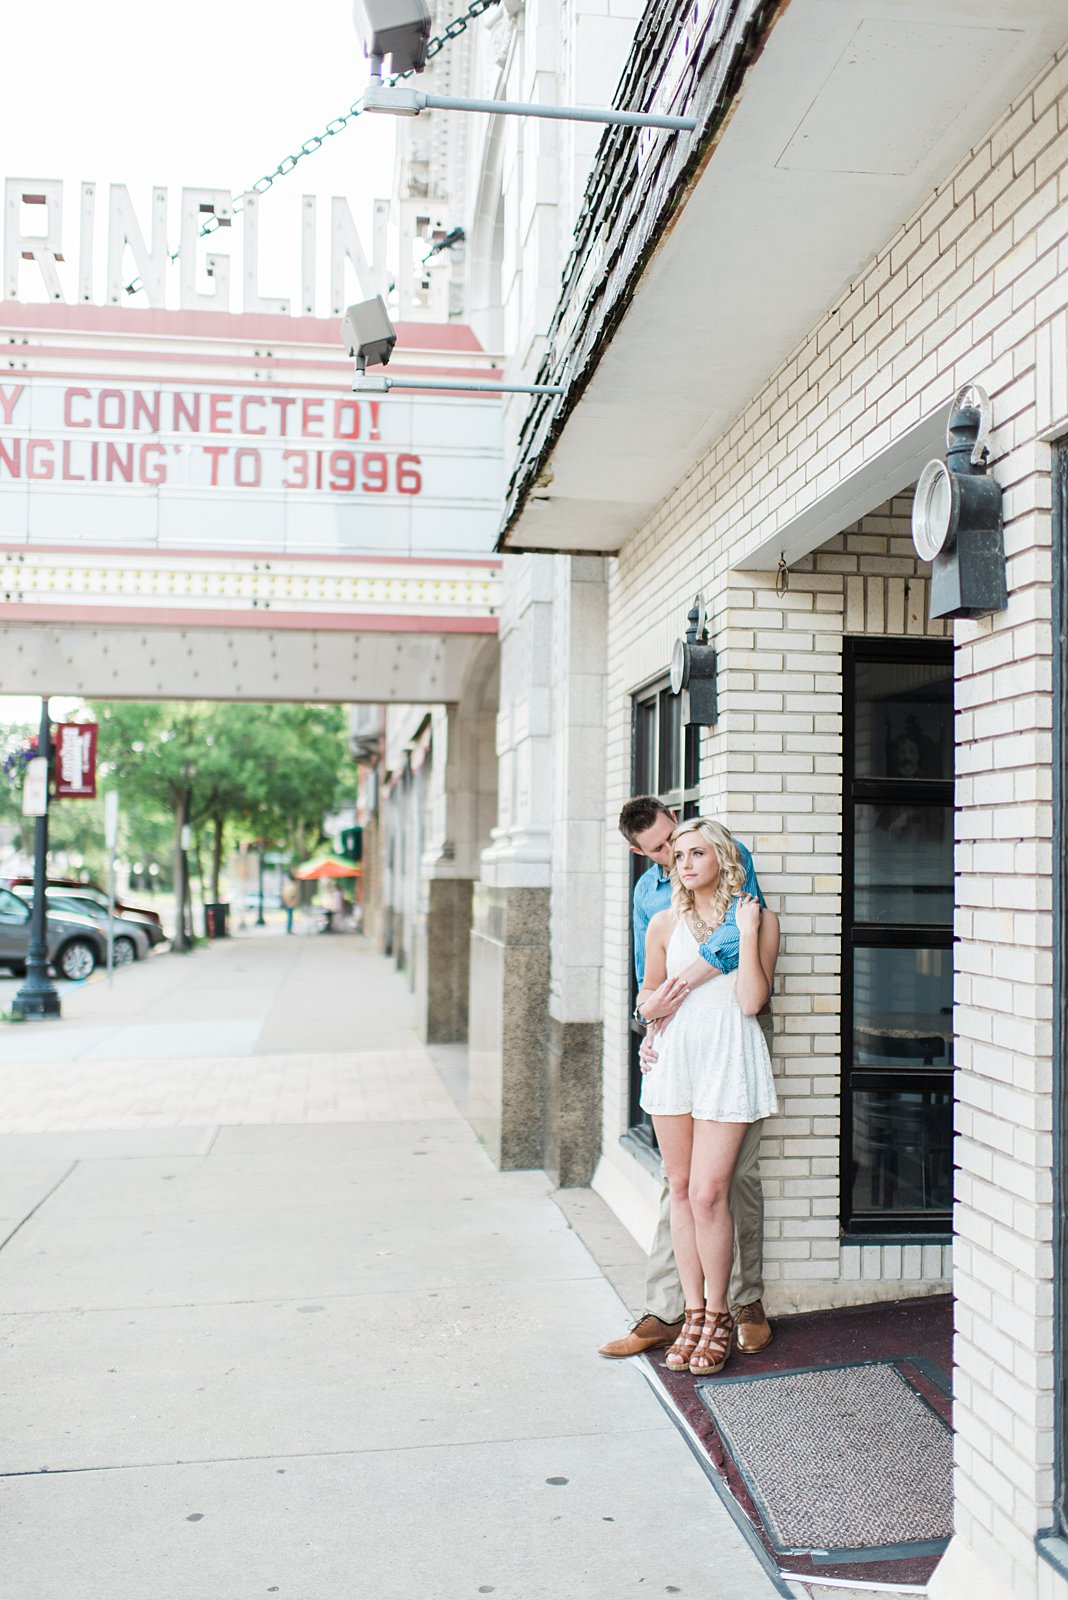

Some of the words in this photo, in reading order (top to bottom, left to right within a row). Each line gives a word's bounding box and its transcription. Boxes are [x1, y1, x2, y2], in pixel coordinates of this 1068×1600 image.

[4, 176, 450, 322] RINGLING
[64, 387, 381, 440] CONNECTED!
[203, 446, 260, 488] TO
[282, 450, 422, 495] 31996
